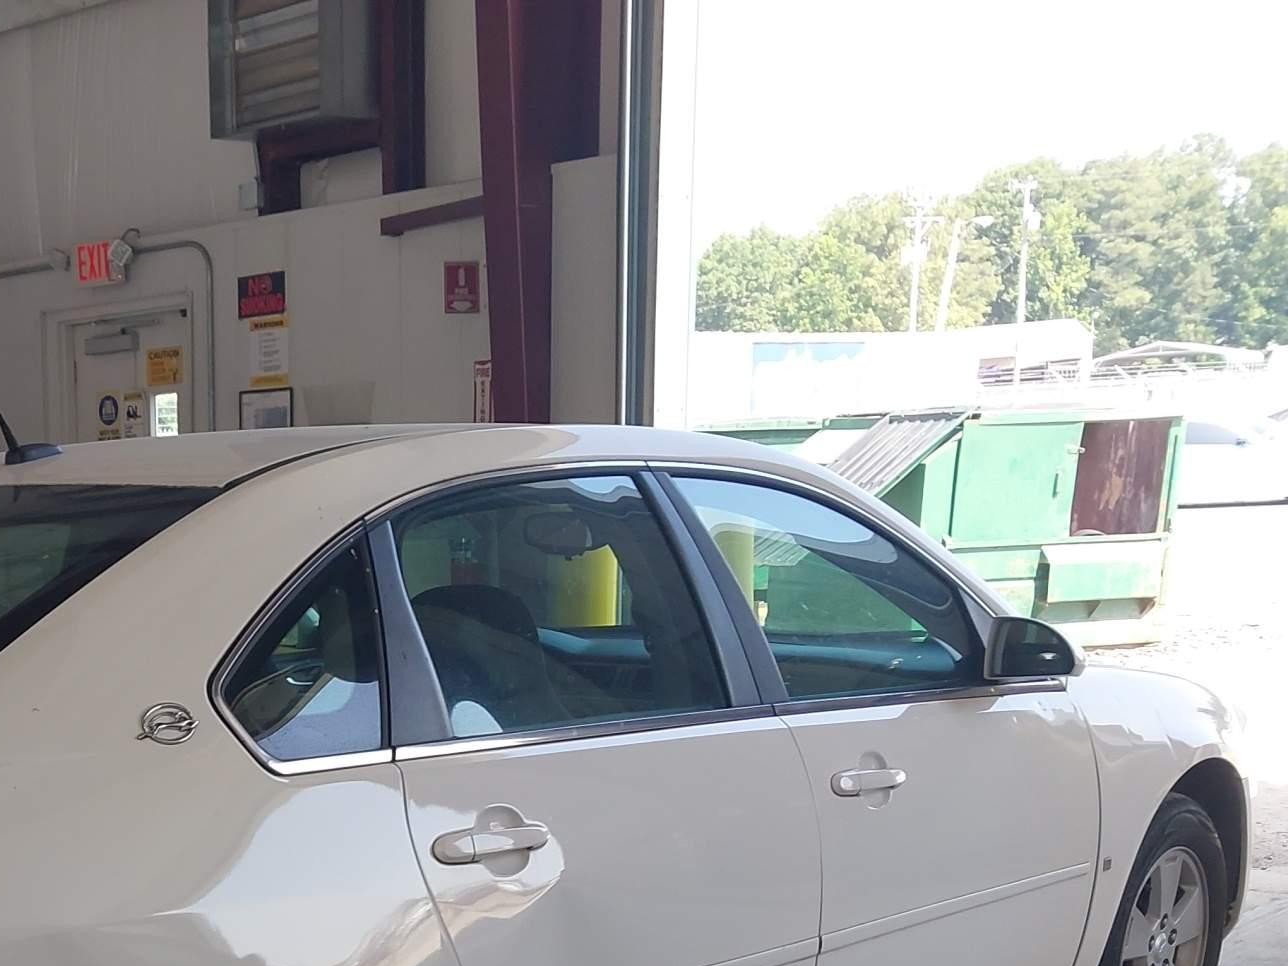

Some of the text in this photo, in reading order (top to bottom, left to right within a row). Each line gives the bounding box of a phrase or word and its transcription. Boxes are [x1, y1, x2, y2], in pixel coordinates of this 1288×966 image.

[78, 241, 109, 282] EXIT
[248, 275, 273, 296] NO
[148, 349, 179, 360] CAUTION
